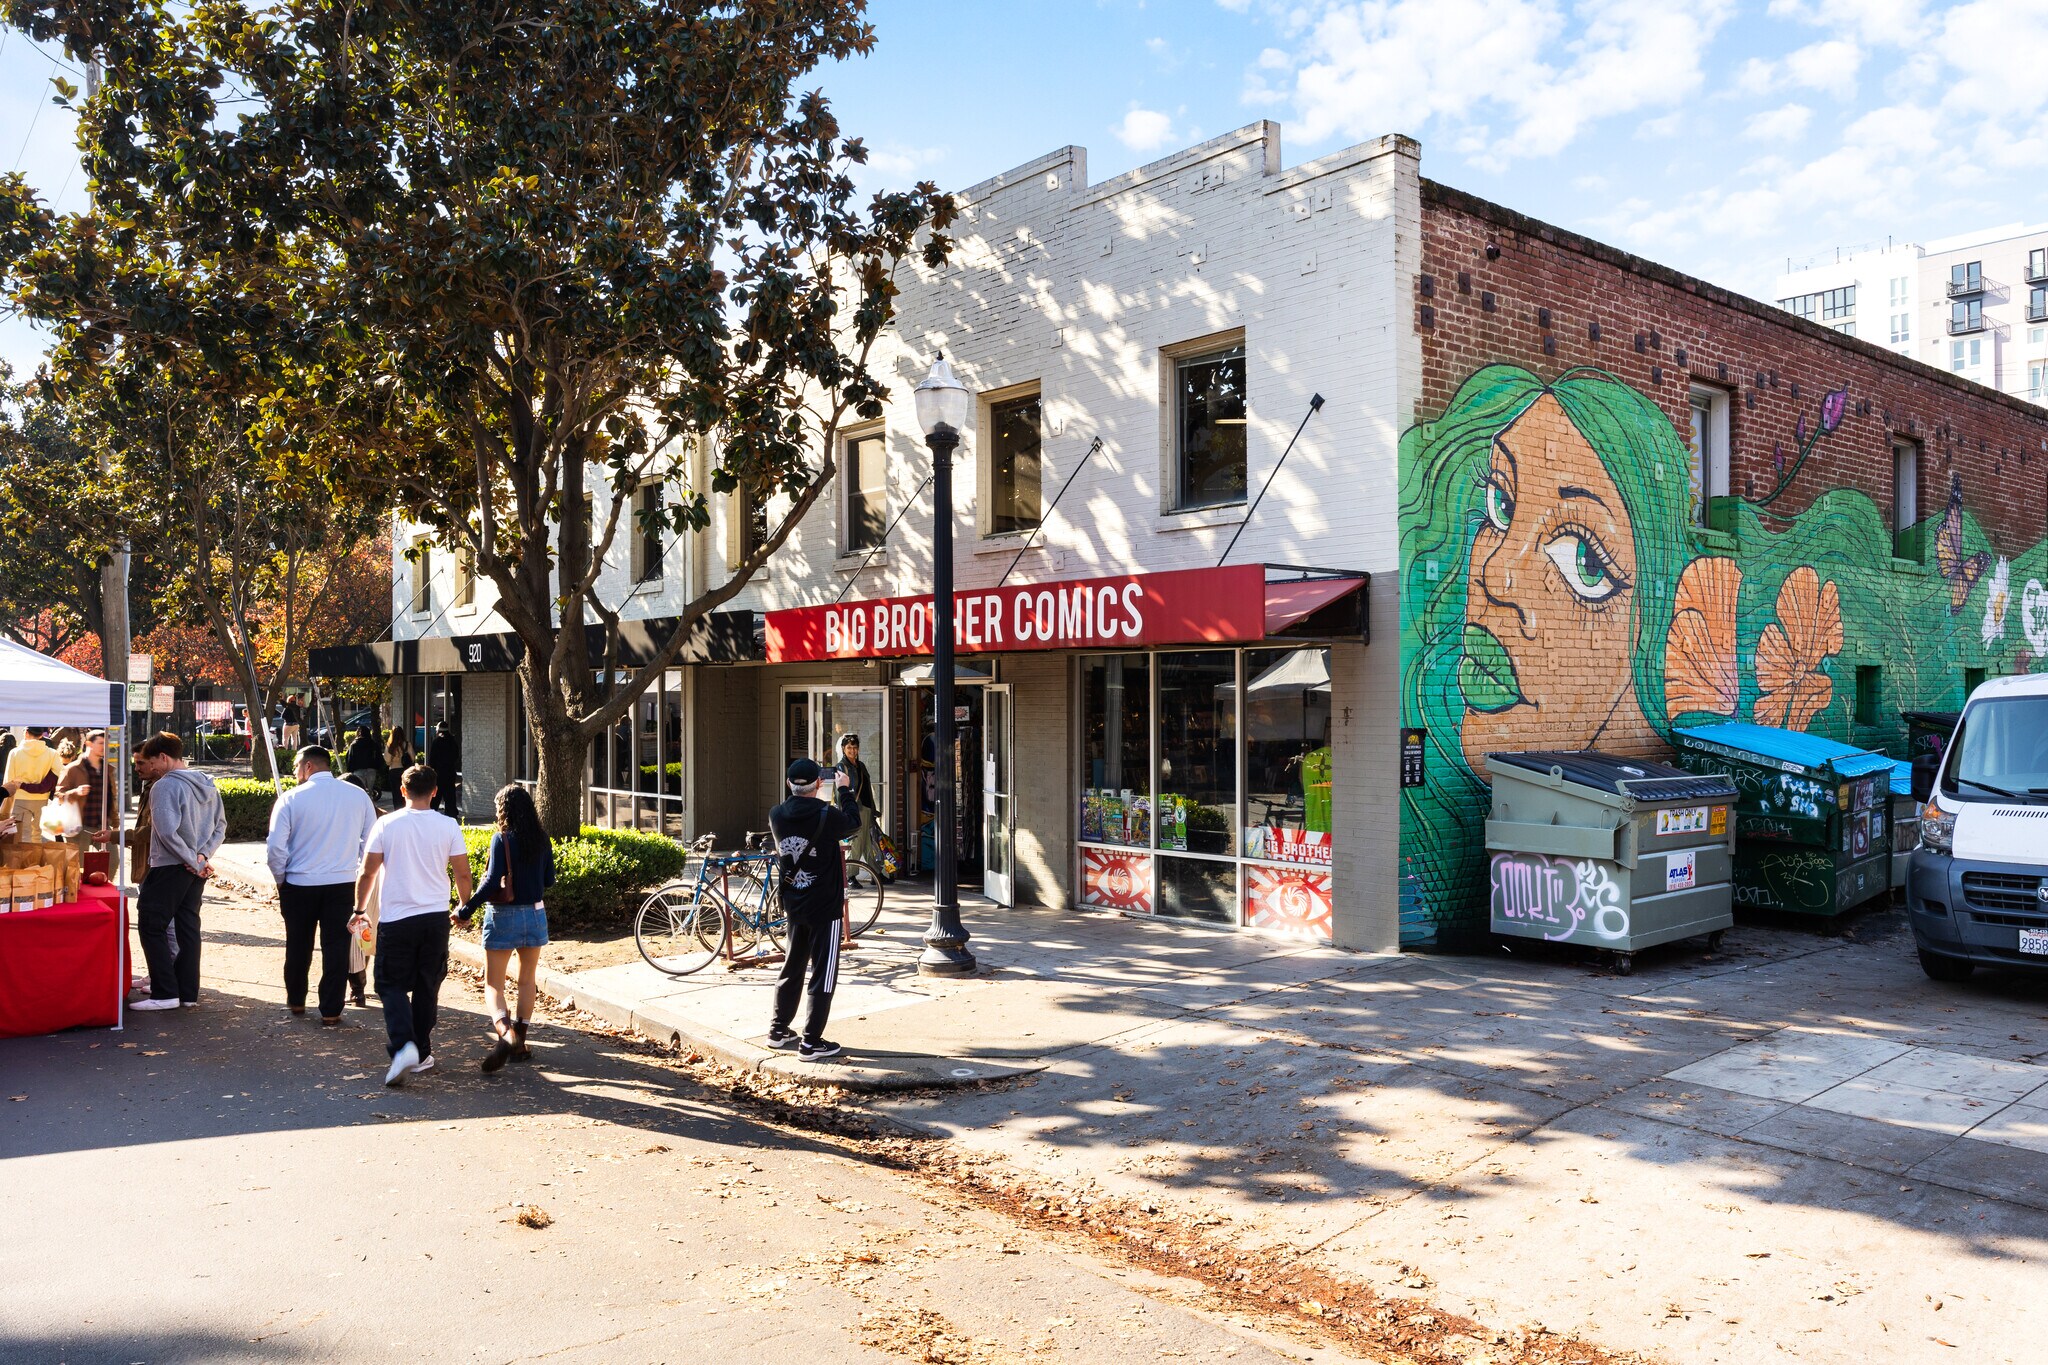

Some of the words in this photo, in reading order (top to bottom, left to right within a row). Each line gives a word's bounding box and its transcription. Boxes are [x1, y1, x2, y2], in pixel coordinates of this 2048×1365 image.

[826, 608, 866, 652] BIG
[1014, 583, 1143, 642] COMICS
[469, 643, 482, 662] 920
[1670, 808, 1685, 817] TRASH
[1685, 808, 1698, 817] ONLY
[1283, 842, 1332, 860] BROTHE
[1669, 867, 1688, 879] ATLAS
